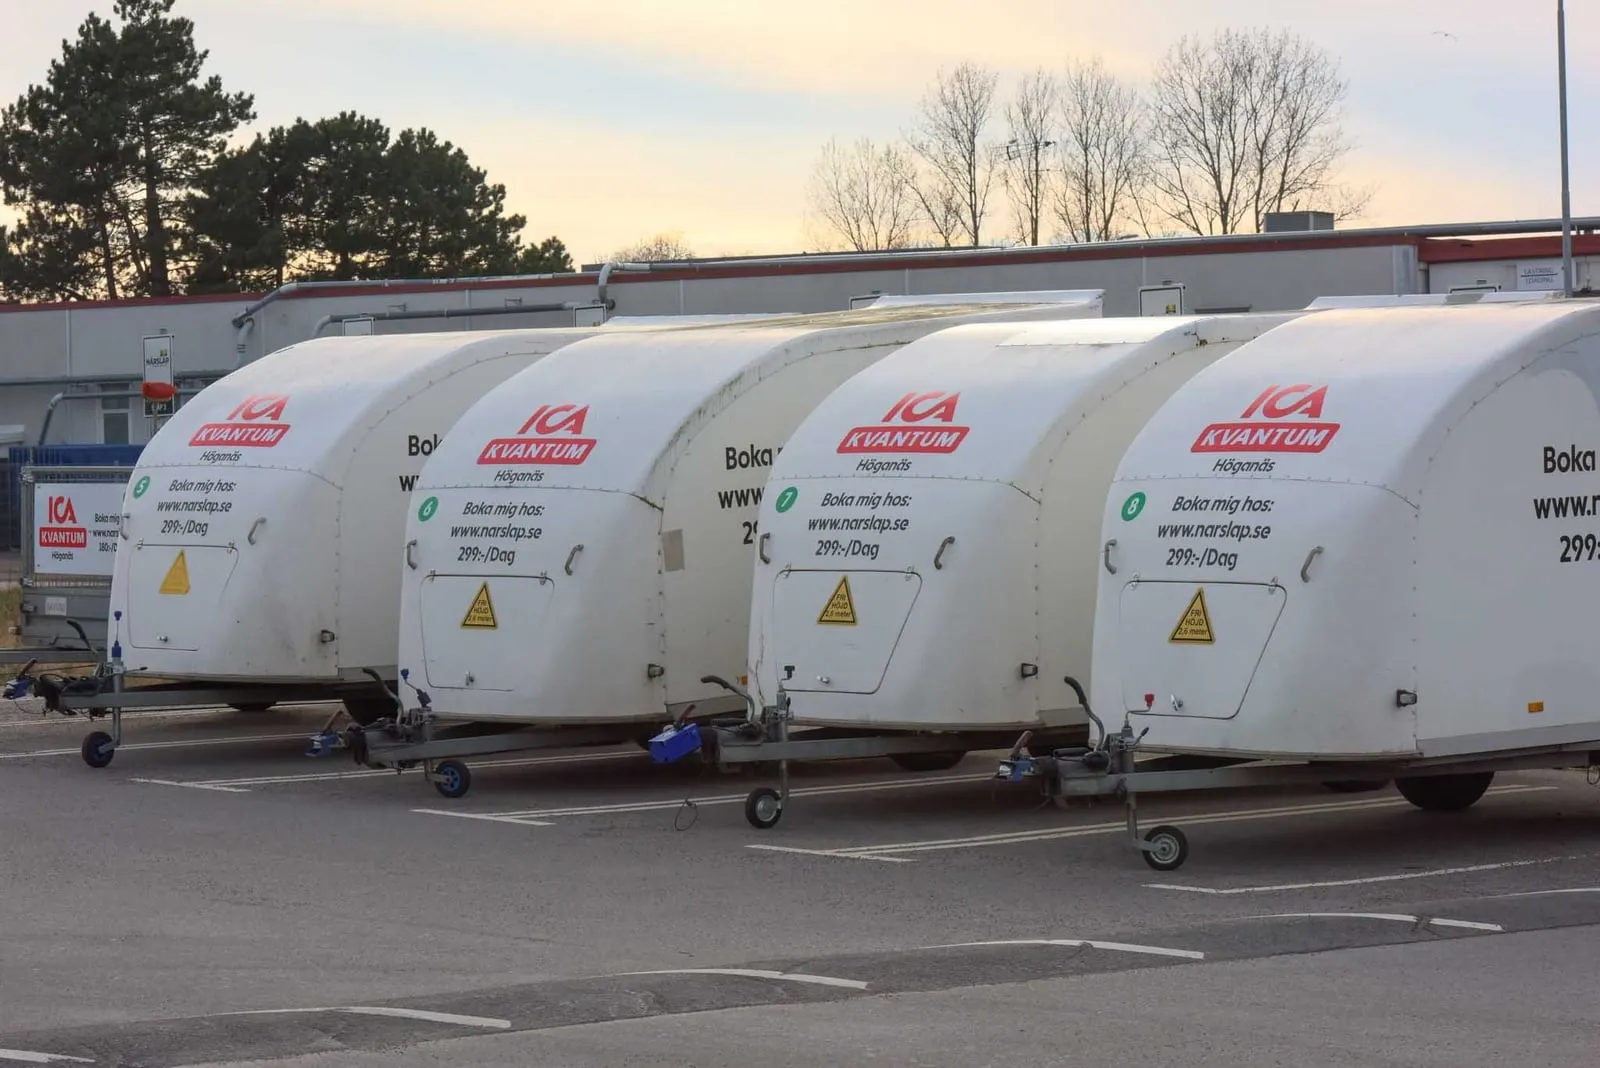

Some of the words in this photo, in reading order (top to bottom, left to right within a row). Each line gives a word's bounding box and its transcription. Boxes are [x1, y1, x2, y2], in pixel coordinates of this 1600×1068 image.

[226, 393, 291, 420] ICA
[881, 391, 961, 422] ICA
[1240, 384, 1329, 419] ICA
[516, 404, 590, 434] ICA
[197, 427, 283, 442] KVANTUM
[845, 430, 961, 448] KVANTUM
[1199, 428, 1330, 447] KVANTUM
[200, 450, 242, 464] Höganäs
[485, 442, 588, 460] KVANTUM
[725, 444, 773, 470] Boka
[1543, 444, 1596, 473] Boka
[856, 459, 912, 474] Höganäs
[1213, 458, 1275, 473] Höganäs
[168, 478, 192, 492] Boka
[194, 480, 213, 494] mig
[214, 479, 237, 492] hos:
[494, 470, 544, 485] Höganäs
[157, 499, 232, 515] www.narslap.se
[422, 501, 433, 516] 6
[781, 492, 793, 508] 7
[821, 492, 855, 507] Boka
[855, 493, 881, 509] mig
[882, 492, 912, 507] hos:
[1127, 498, 1139, 514] 8
[1172, 496, 1210, 512] Boka
[1211, 497, 1239, 514] mig
[1241, 496, 1275, 512] hos:
[48, 495, 77, 524] ICA
[95, 513, 108, 523] Boka
[462, 501, 495, 516] Boka
[497, 503, 517, 519] mig
[518, 502, 545, 516] hos:
[161, 519, 208, 536] 299:-/Dag
[450, 522, 542, 541] www.narslap.se
[808, 515, 910, 534] www.narslap.se
[1157, 521, 1271, 542] www.narslap.se
[41, 531, 85, 544] KVANTUM
[52, 551, 74, 561] Höganäs
[457, 546, 515, 566] 299:-/Dag
[815, 539, 880, 561] 299:-/Dag
[1166, 548, 1238, 571] 299:-/Dag
